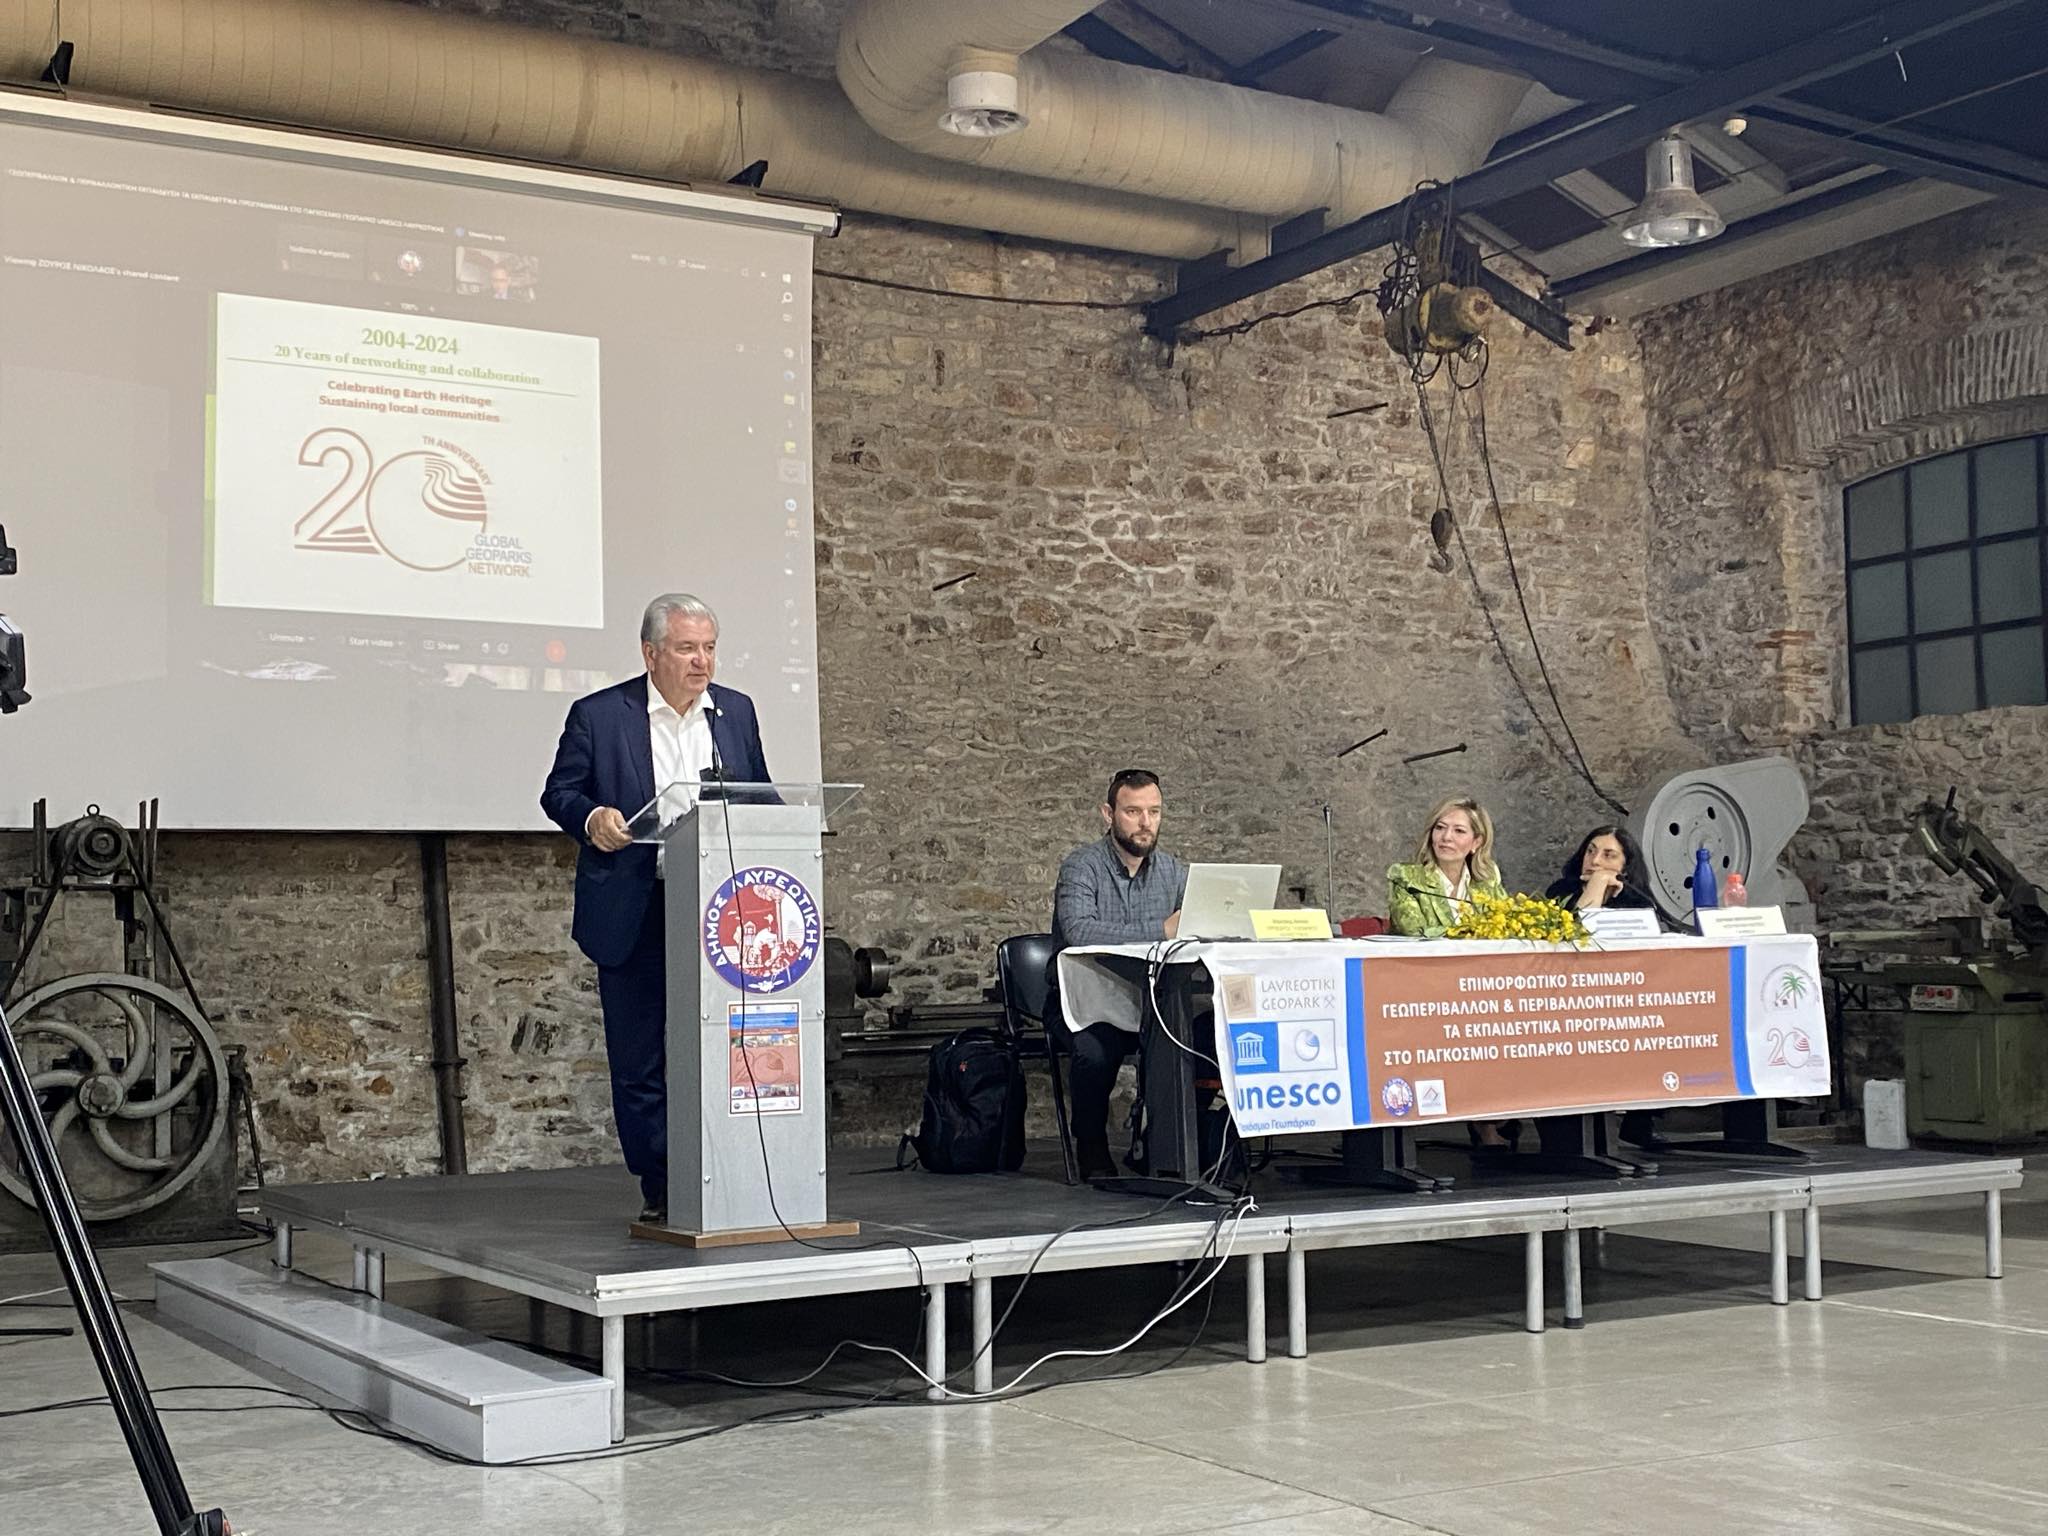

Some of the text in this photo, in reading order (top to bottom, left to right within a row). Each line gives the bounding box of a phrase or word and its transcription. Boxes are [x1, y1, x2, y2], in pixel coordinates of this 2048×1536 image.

[361, 327, 460, 355] 2004-2024
[274, 344, 541, 386] 20 Years of networking and collaboration
[327, 380, 492, 407] Celebrating Earth Heritage
[319, 395, 500, 423] Sustaining local communities
[422, 435, 494, 486] TH ANNIVERSARY
[474, 533, 523, 550] GLOBAL
[465, 547, 533, 565] GEOPARKS
[467, 561, 532, 577] NETWORK
[706, 893, 728, 967] ΔΗΜΟΣ
[1260, 978, 1336, 993] LAVREOTIKI
[1459, 971, 1645, 992] ΕΠΙΜΟΡΦΩΤΙΚΟ ΣΕΜΙΝΑΡΙΟ
[1261, 996, 1321, 1011] GEOPARK
[1382, 990, 1716, 1018] ΓΕΩΠΕΡΙΒΑΛΛΟΝ & ΠΕΡΙΒΑΛΛΟΝΤΙΚΗ ΕΚΠΑΙΔΕΥΣΗ
[1443, 1014, 1665, 1039] ΤΑ ΕΚΠΑΙΔΕΥΤΙΚΑ ΠΡΟΓΡΑΜΜΑΤΑ
[1384, 1034, 1719, 1066] ΣΤΟ ΠΑΓΚΟΣΜΙΟ ΓΕΩΠΑΡΚΟ UNESCO ΛΑΥΡΕΩΤΙΚΗΣ
[1237, 1082, 1341, 1112] unesco
[1271, 1117, 1316, 1130] Γεωπάρκο
